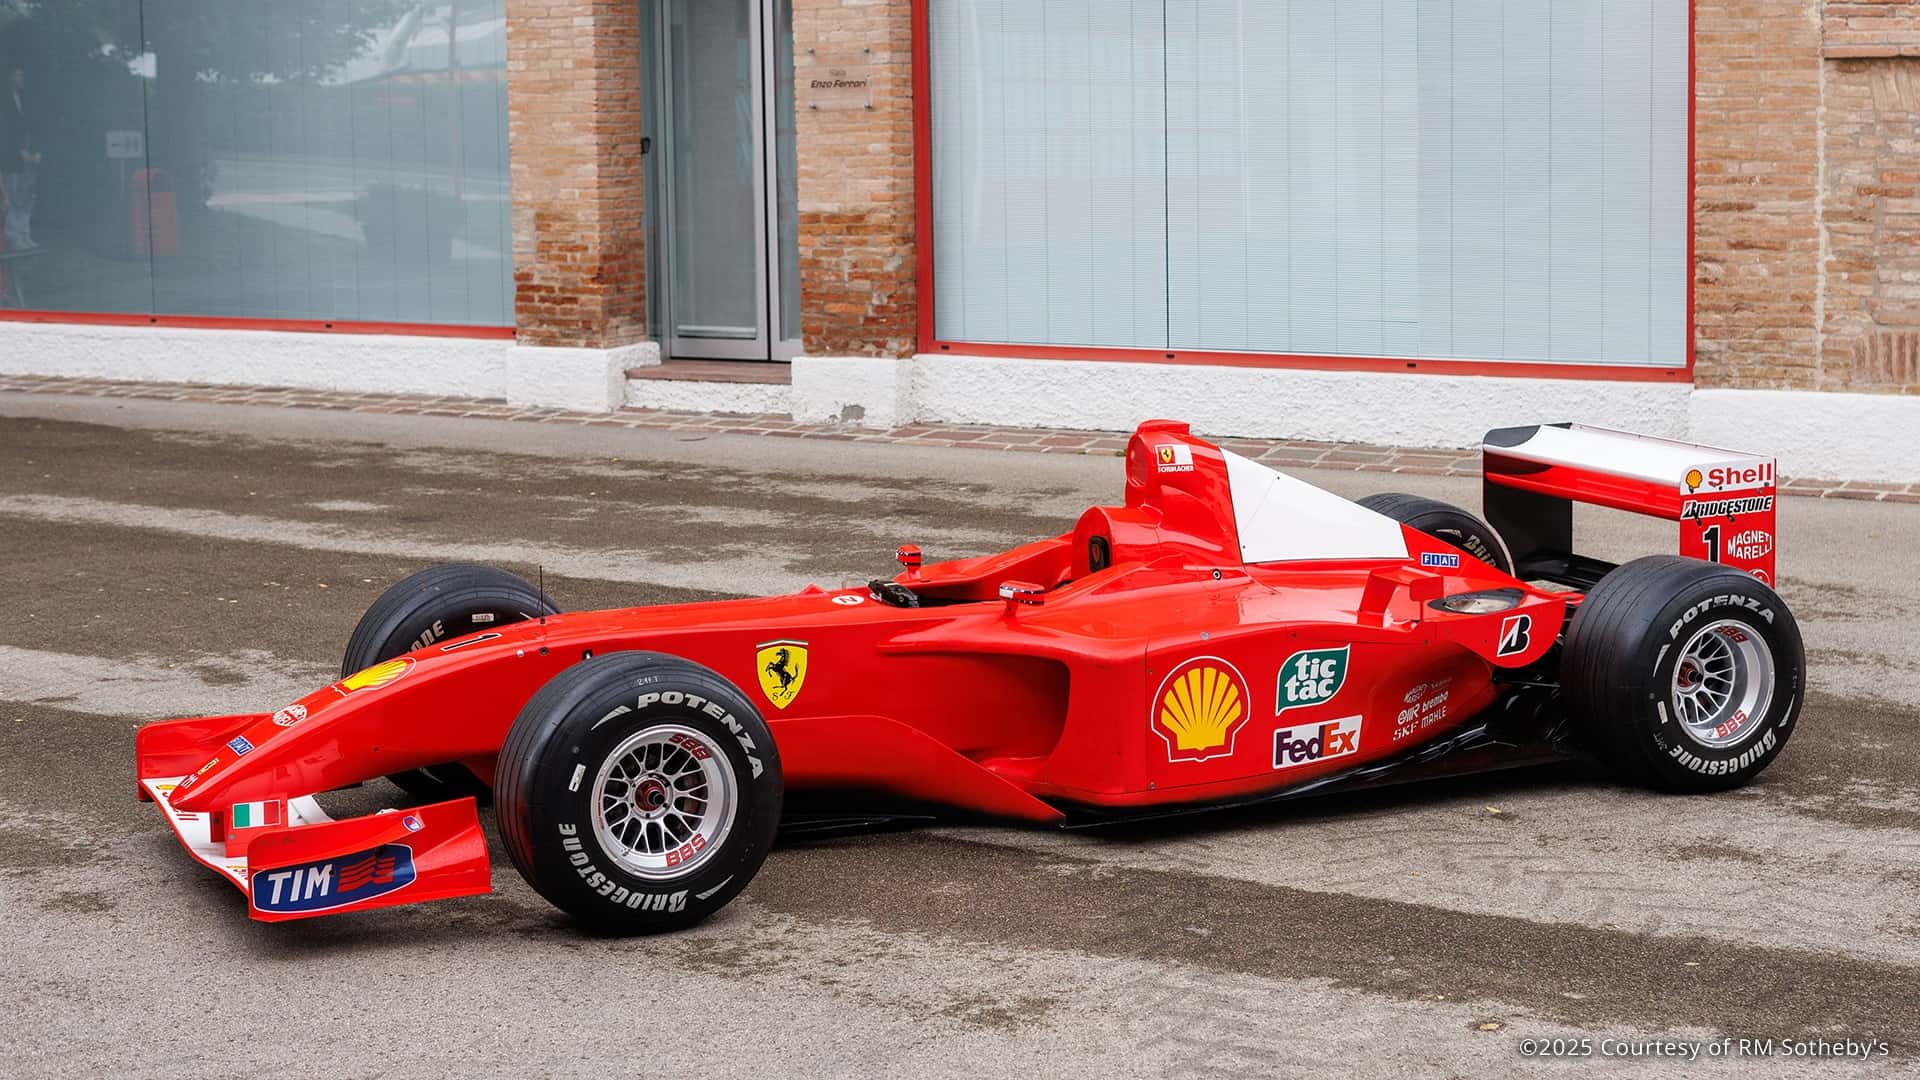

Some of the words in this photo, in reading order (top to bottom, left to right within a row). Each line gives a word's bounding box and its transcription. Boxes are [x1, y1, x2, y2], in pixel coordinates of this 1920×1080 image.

[810, 80, 833, 88] Enzo
[834, 79, 867, 88] Ferrari
[1707, 463, 1772, 487] Shell
[1681, 496, 1773, 519] BRIDGESTONE
[1703, 525, 1720, 563] 1
[1727, 530, 1772, 553] MAGNETI
[1727, 541, 1772, 560] MARELLI
[1423, 554, 1458, 567] FIAT
[1669, 594, 1775, 640] POTENZA
[1295, 653, 1336, 681] tic
[1284, 674, 1334, 702] tac
[1422, 705, 1447, 729] MAHLE
[1715, 709, 1749, 738] BBS
[637, 691, 764, 779] POTENZA
[1275, 721, 1357, 766] FedEx
[1669, 727, 1777, 776] BRIDGESTONE
[665, 833, 707, 868] BBS
[558, 823, 689, 913] BRIDGESTONE
[267, 863, 334, 905] TIM
